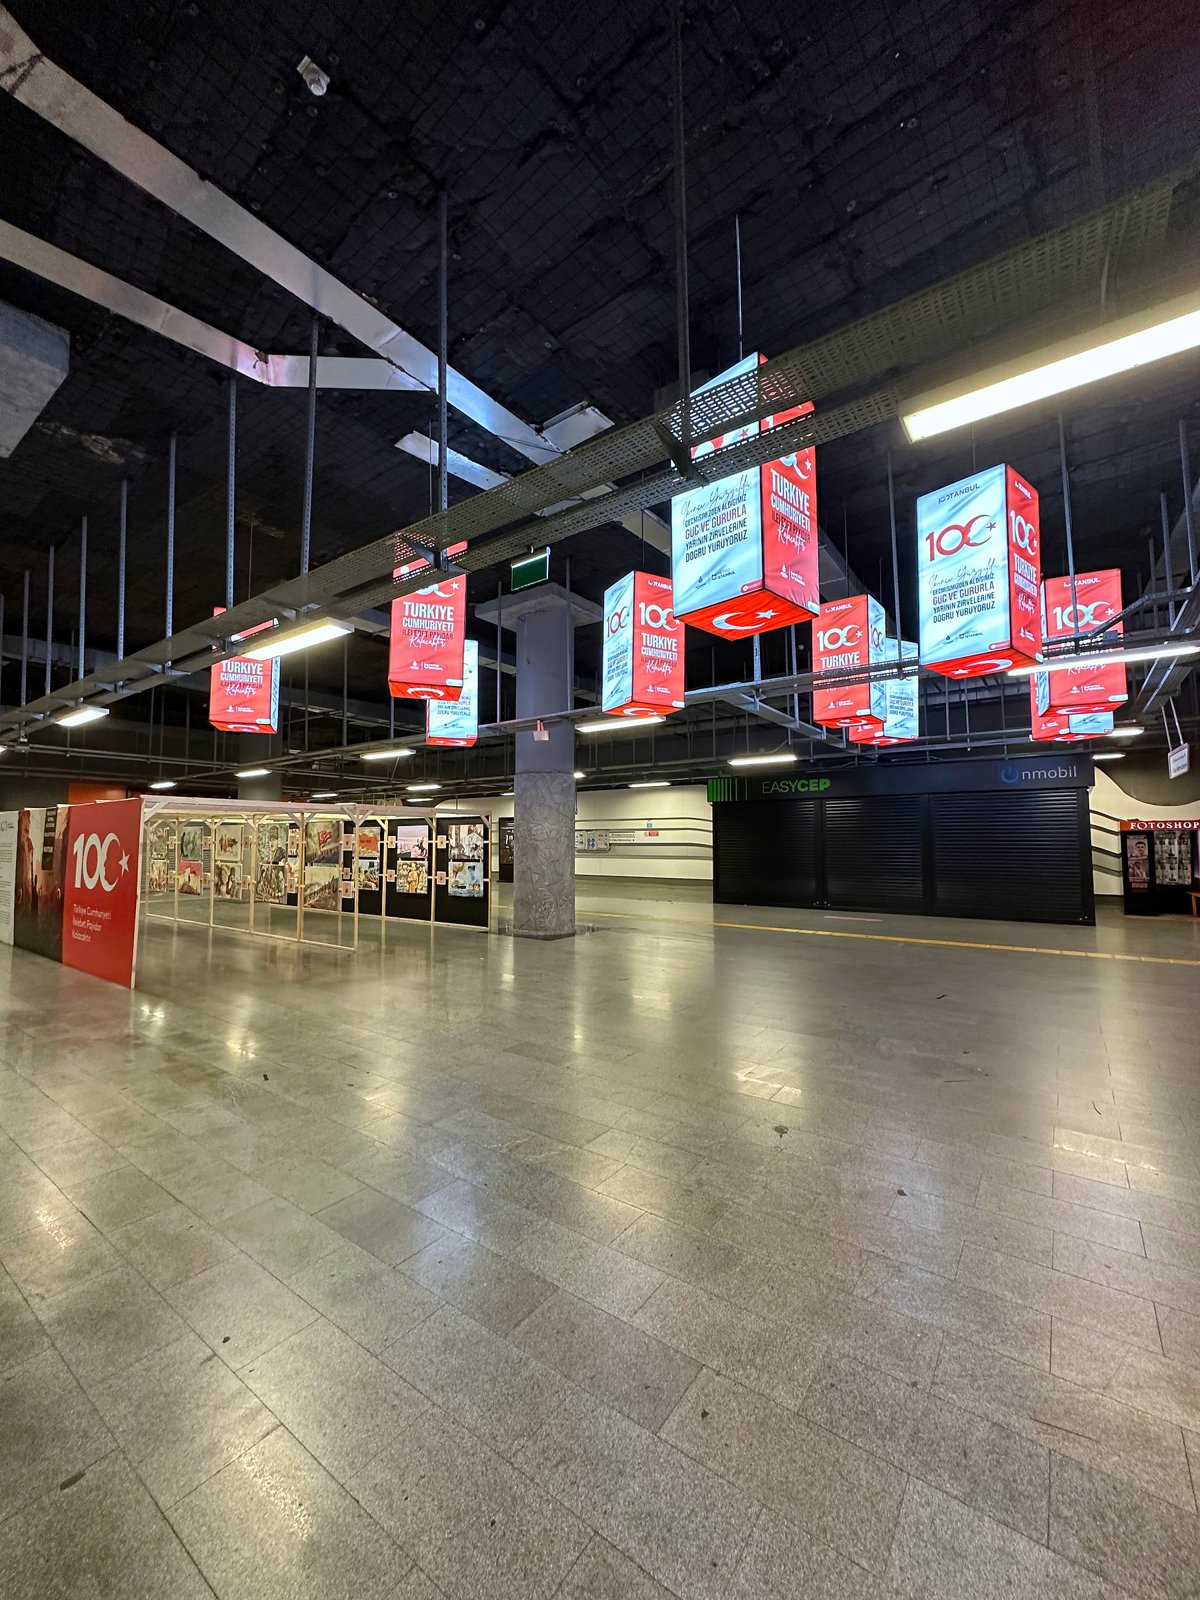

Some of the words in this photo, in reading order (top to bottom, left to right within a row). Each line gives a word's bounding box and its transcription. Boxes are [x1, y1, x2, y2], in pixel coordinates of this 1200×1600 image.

[700, 519, 710, 533] VE
[711, 504, 747, 528] GURURLA
[948, 590, 958, 601] VE
[959, 581, 995, 598] GURURLA
[762, 778, 831, 793] EASYCEP
[1130, 821, 1200, 831] FOTOSHOP
